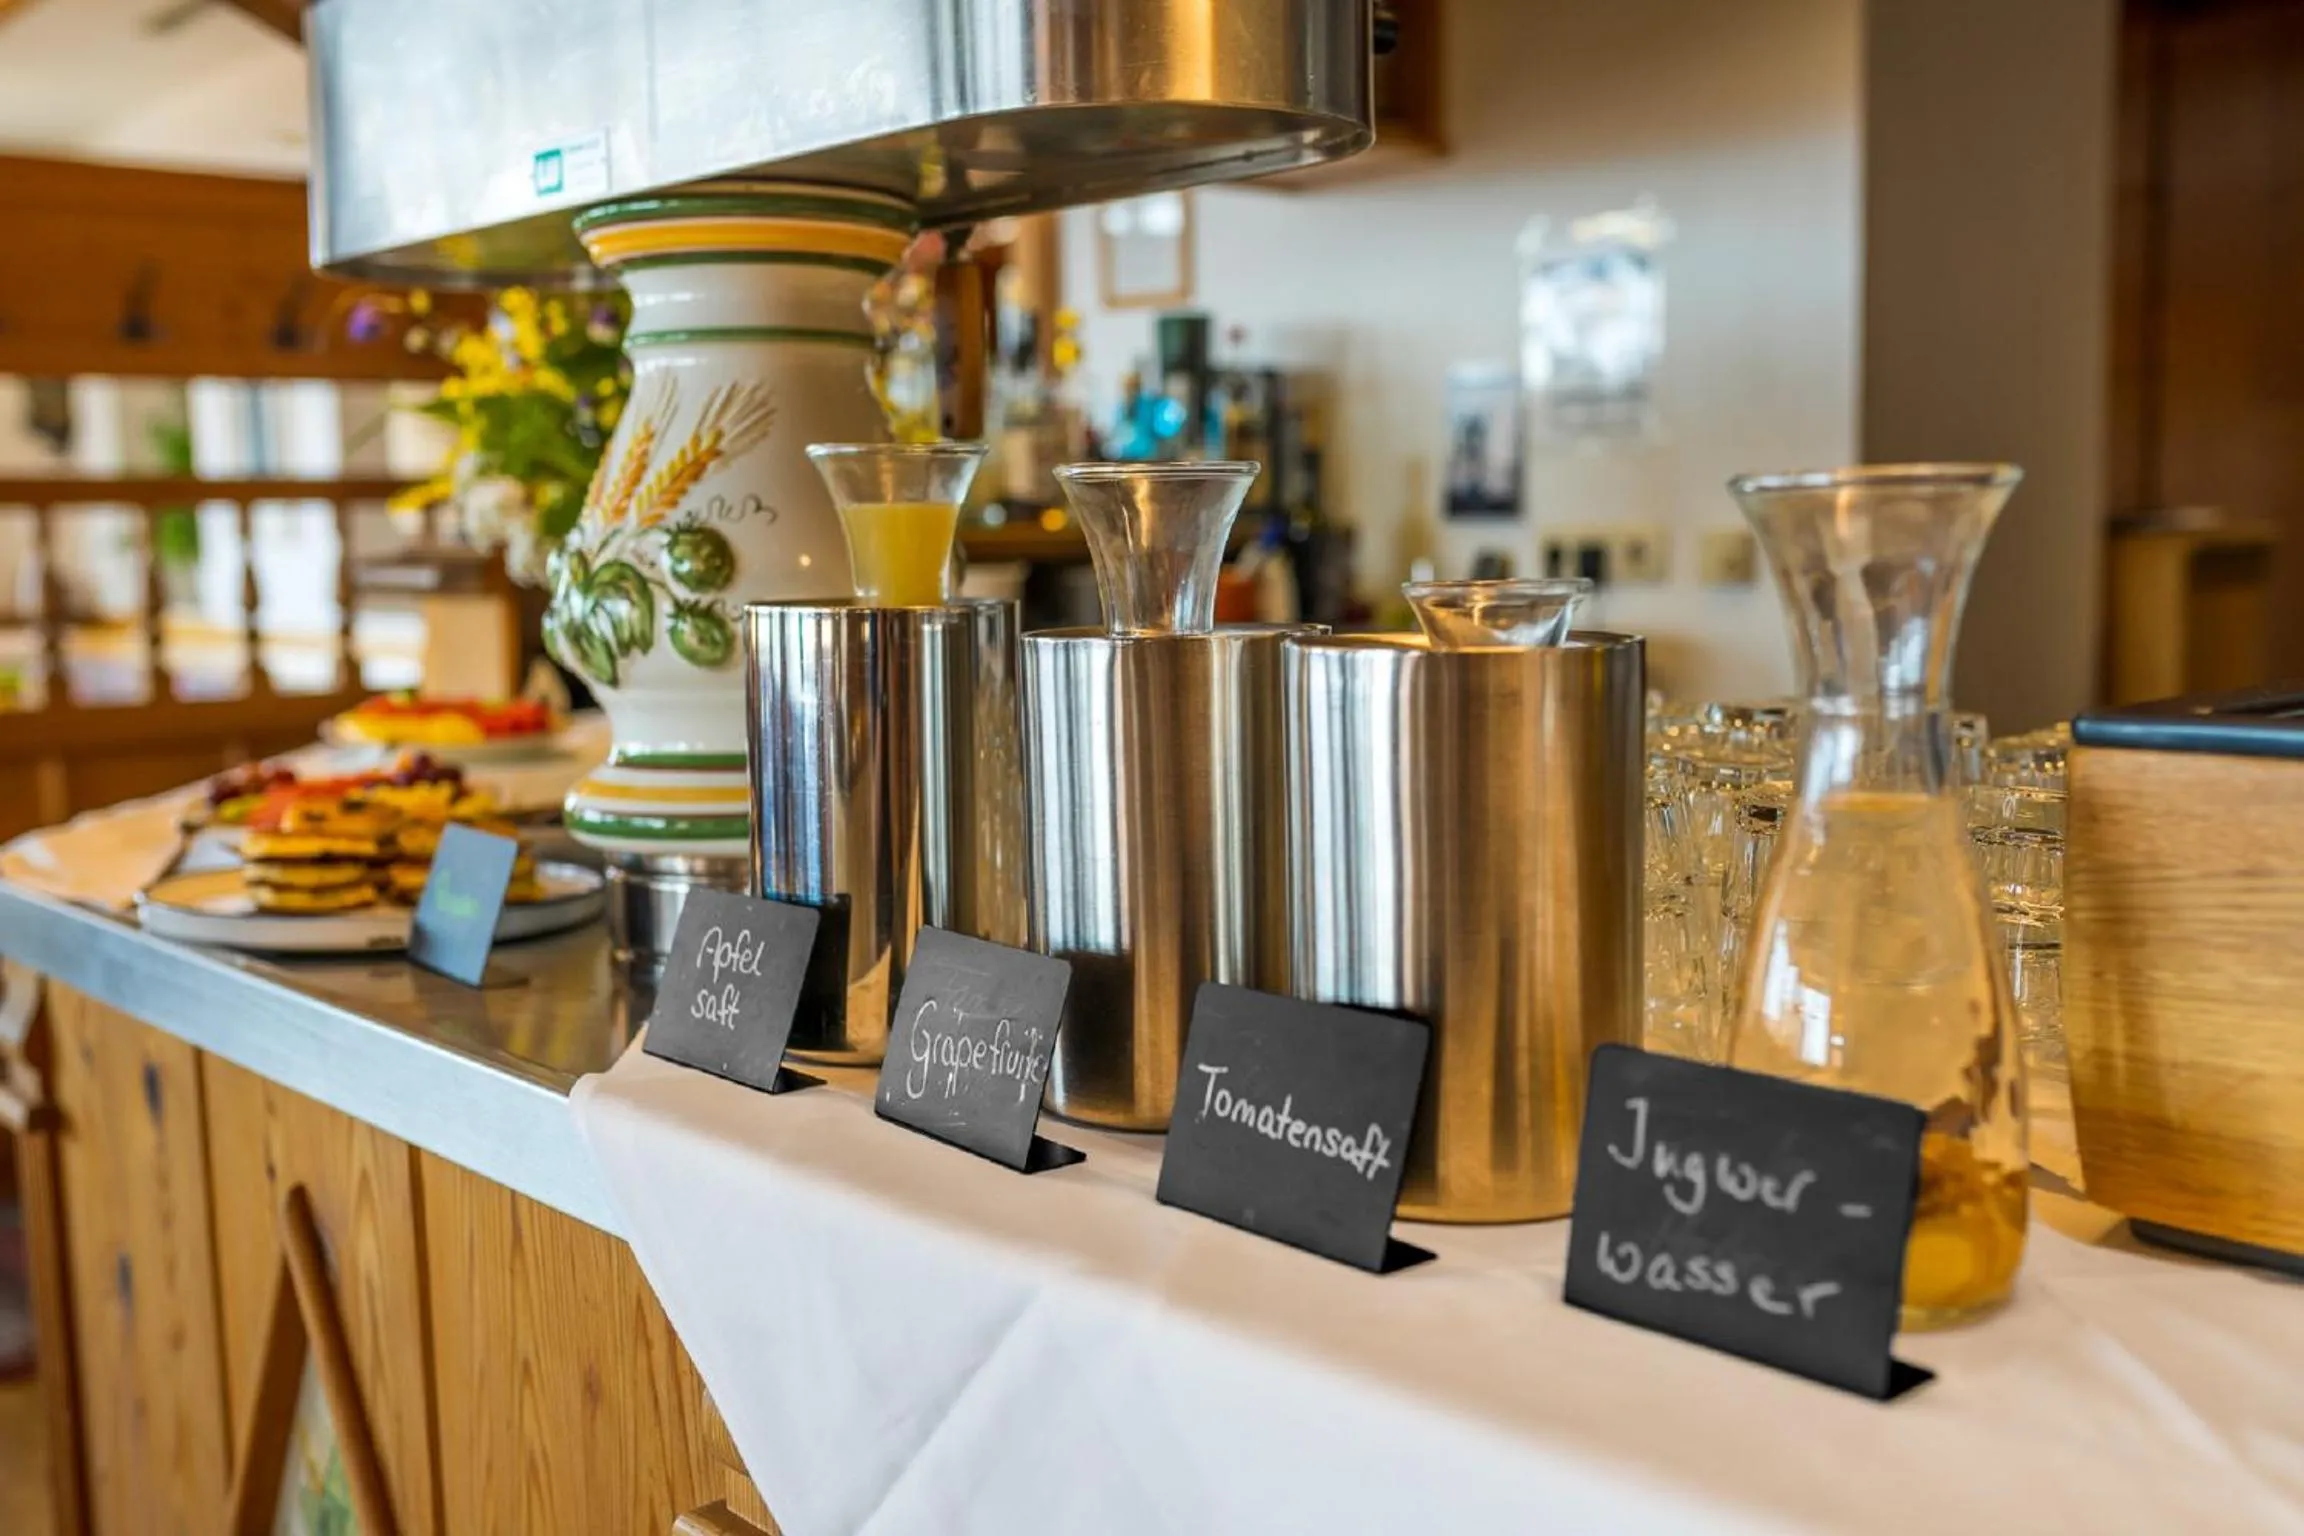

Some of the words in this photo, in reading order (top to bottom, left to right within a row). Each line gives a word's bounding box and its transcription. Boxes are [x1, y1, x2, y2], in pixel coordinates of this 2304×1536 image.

[696, 926, 765, 984] Apfel
[690, 983, 740, 1030] saft
[1198, 1063, 1391, 1180] Tomatensaft
